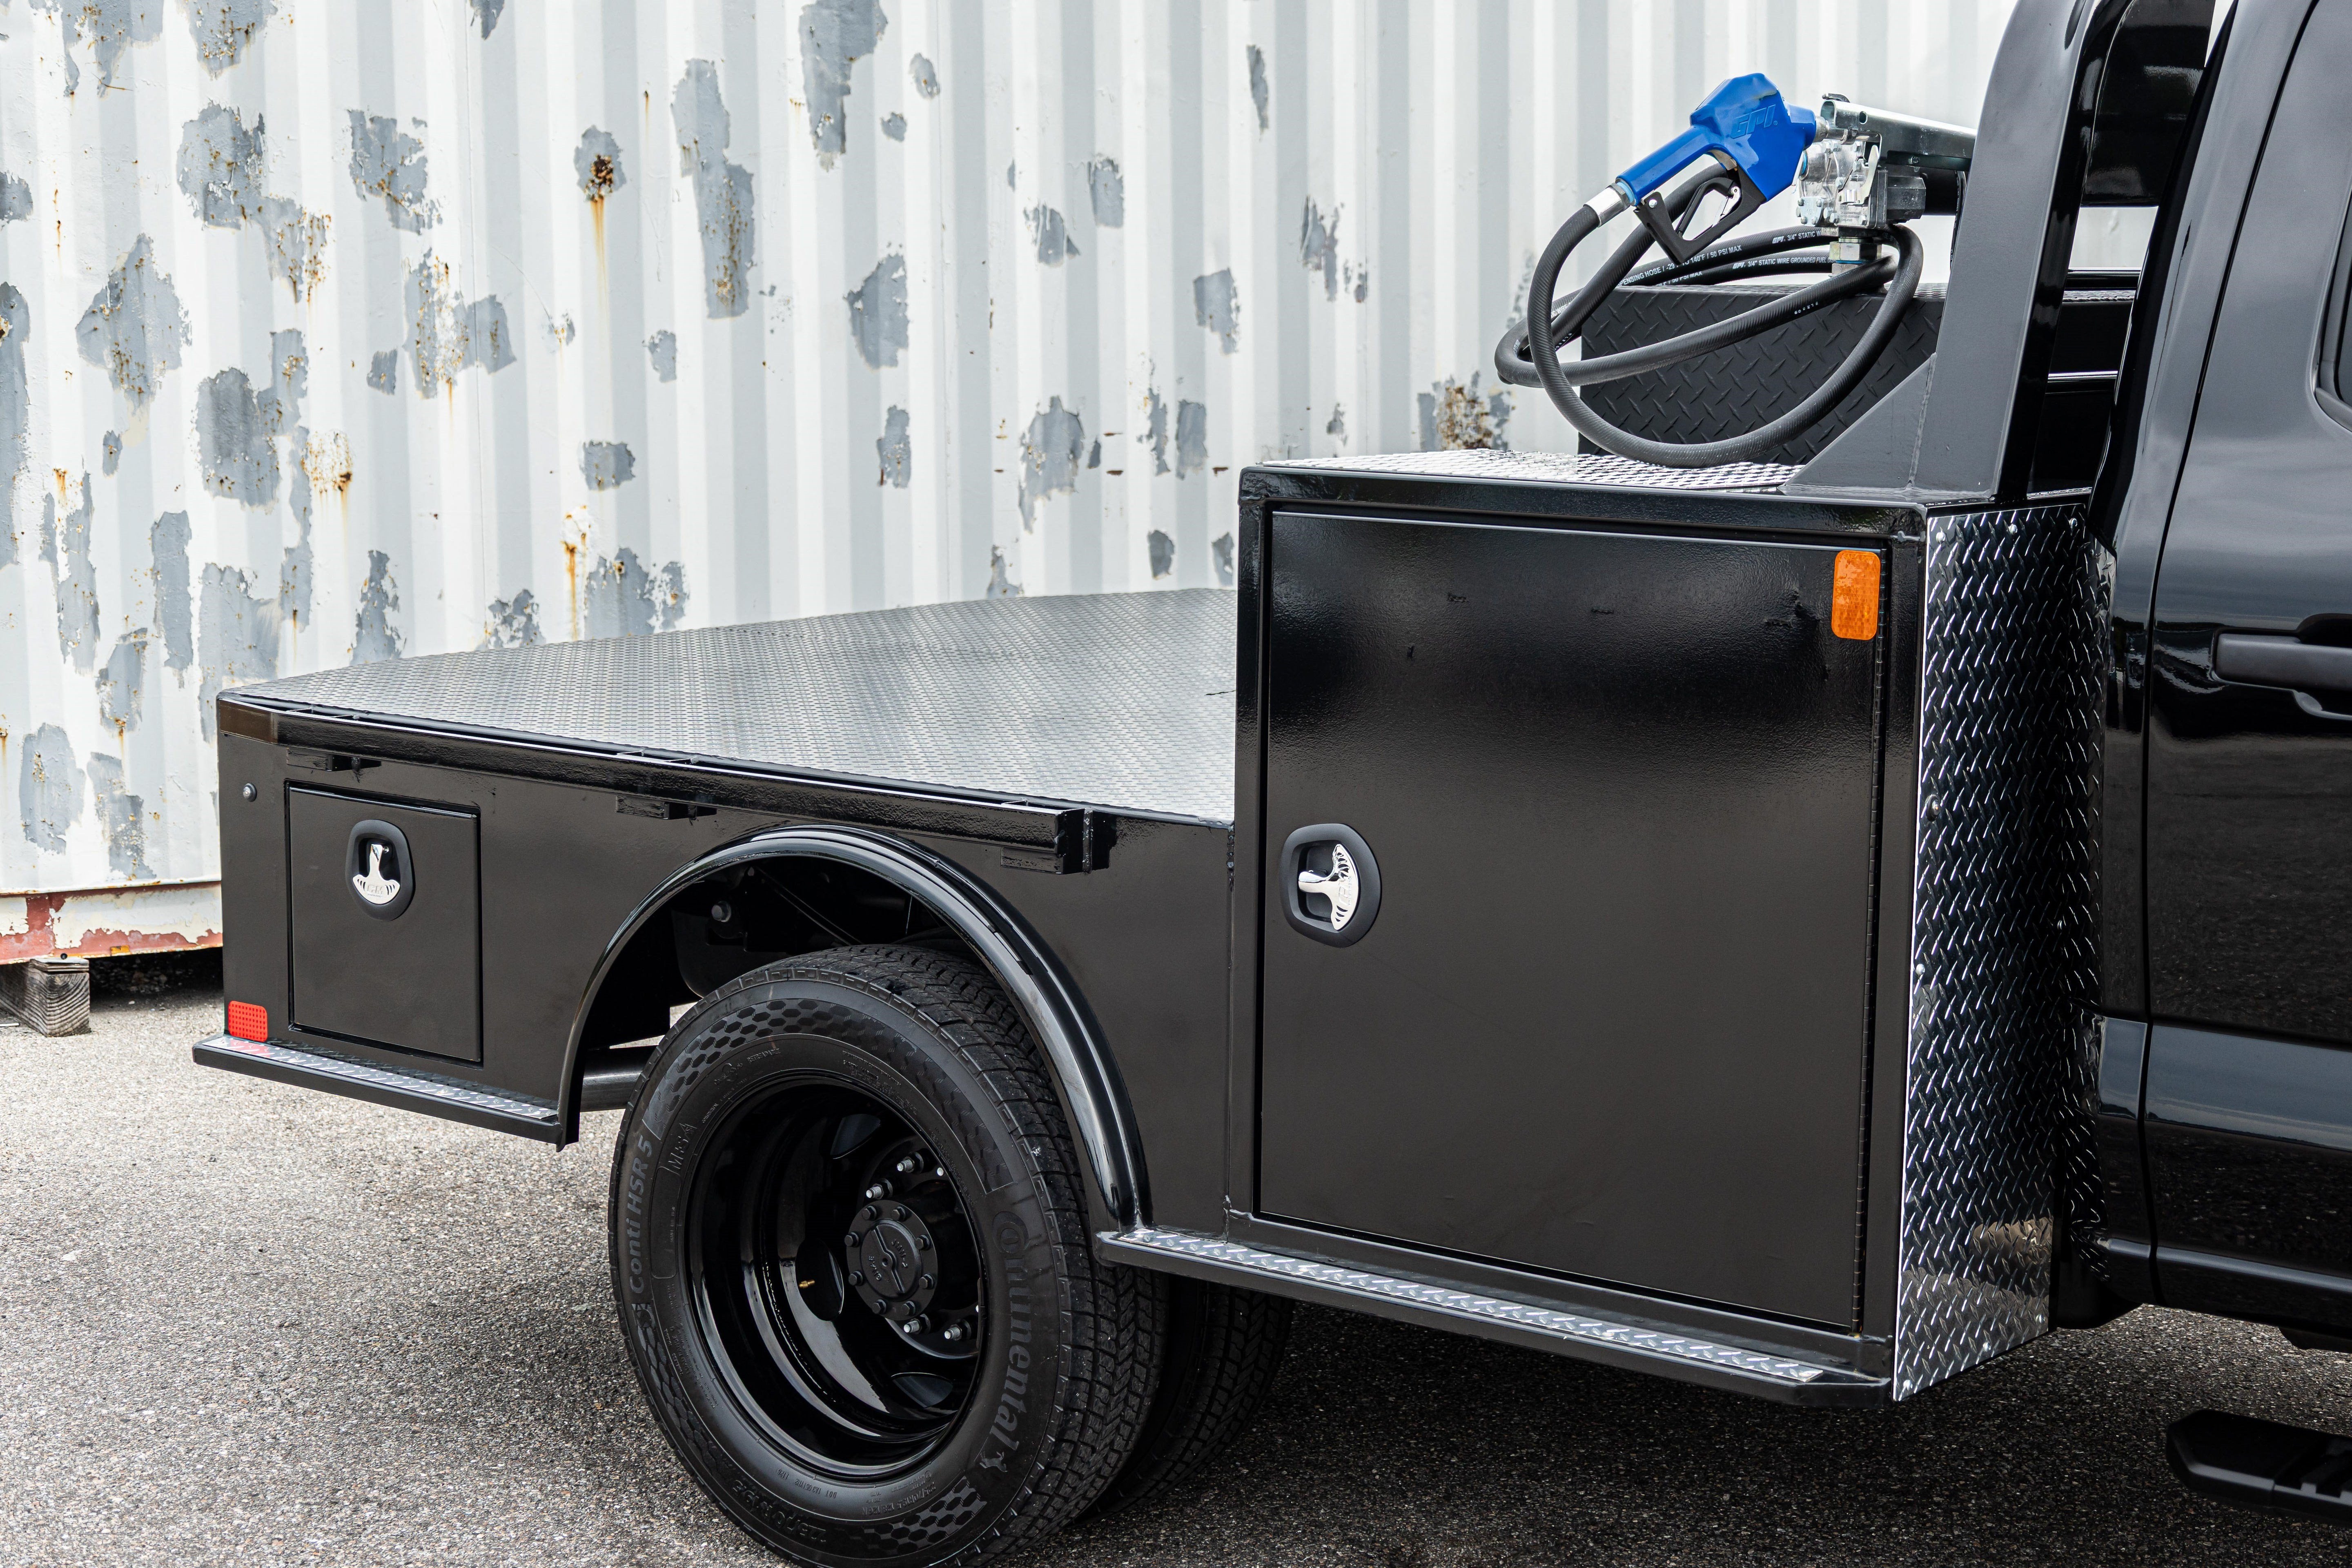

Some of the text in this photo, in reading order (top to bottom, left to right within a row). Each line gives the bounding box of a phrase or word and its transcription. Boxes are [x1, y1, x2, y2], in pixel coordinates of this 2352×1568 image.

[1787, 233, 1797, 241] 3/4"
[1798, 230, 1815, 240] STATIC
[1645, 267, 1662, 277] HOSE
[1729, 245, 1742, 253] MAX
[626, 1134, 653, 1294] Conti HSR 5
[989, 1211, 1032, 1450] Continental
[825, 1490, 837, 1499] DOT
